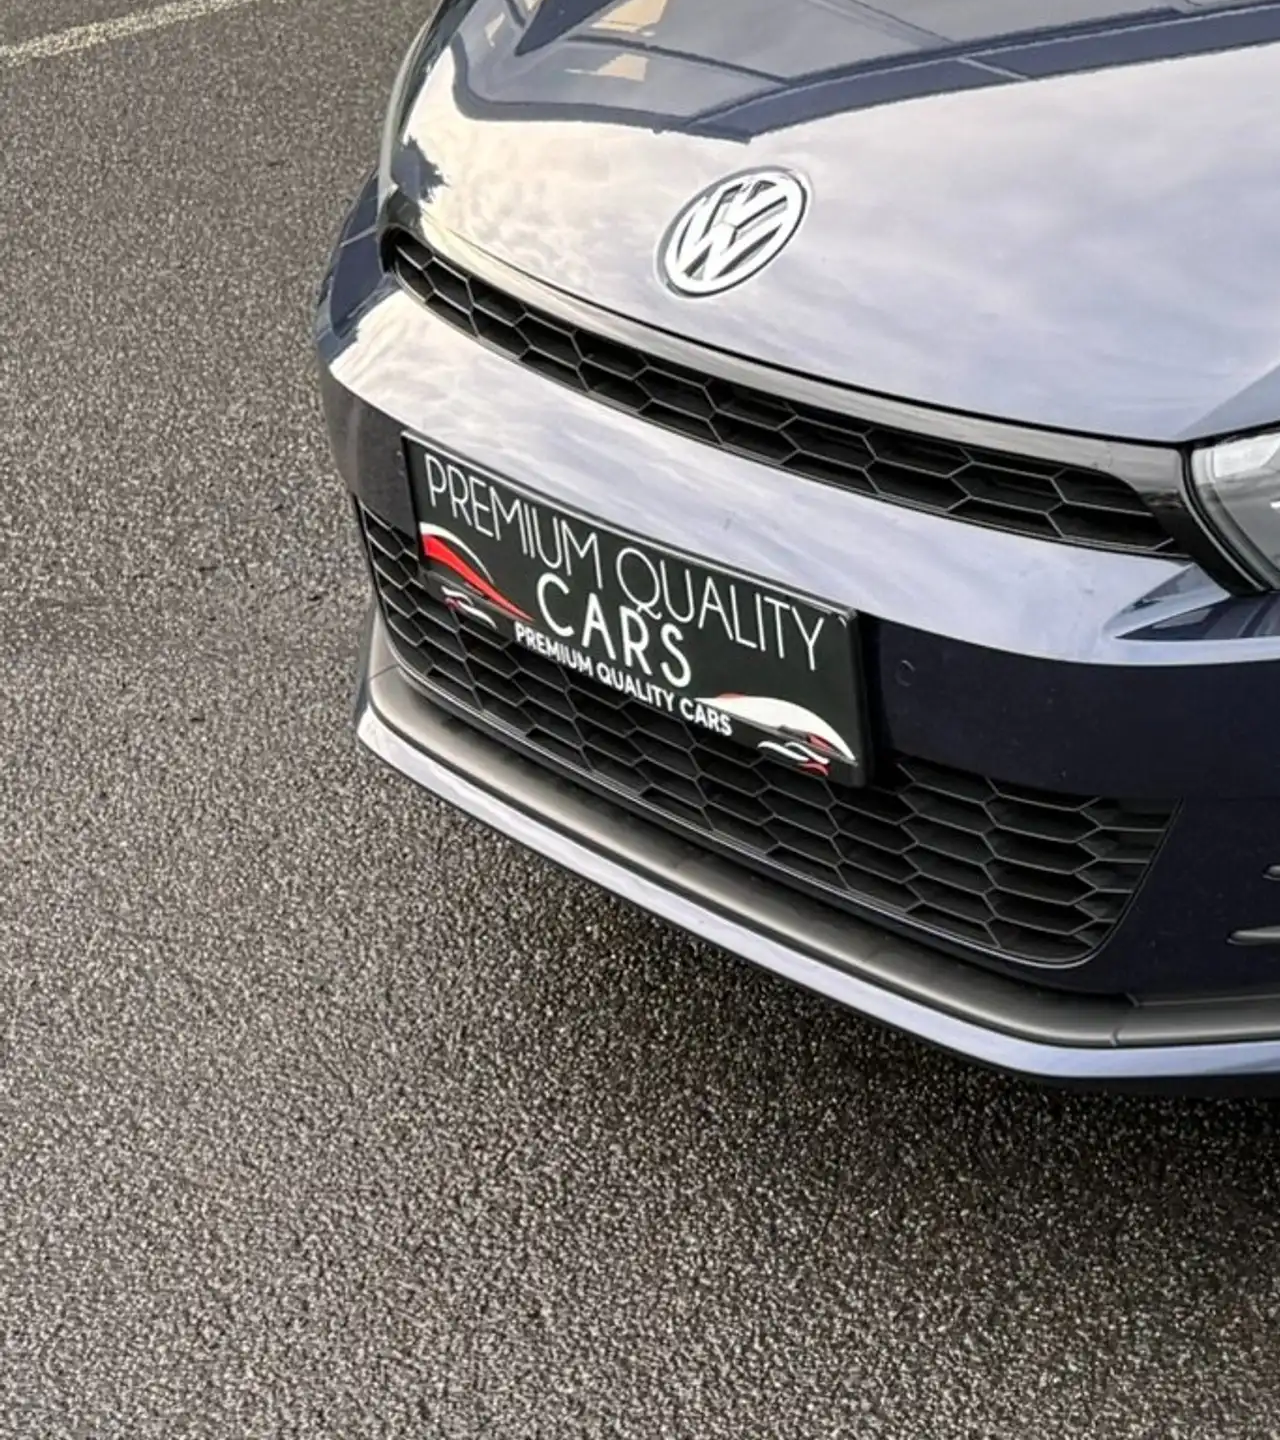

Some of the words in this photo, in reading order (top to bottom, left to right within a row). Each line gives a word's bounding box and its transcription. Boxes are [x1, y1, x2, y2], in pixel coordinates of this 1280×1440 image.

[424, 452, 603, 590] PREMIUM
[615, 546, 825, 672] QUALITY
[514, 620, 594, 677] PREMIUM
[596, 662, 675, 712] QUALITY
[679, 696, 733, 736] CARS
[536, 572, 692, 688] CARS
